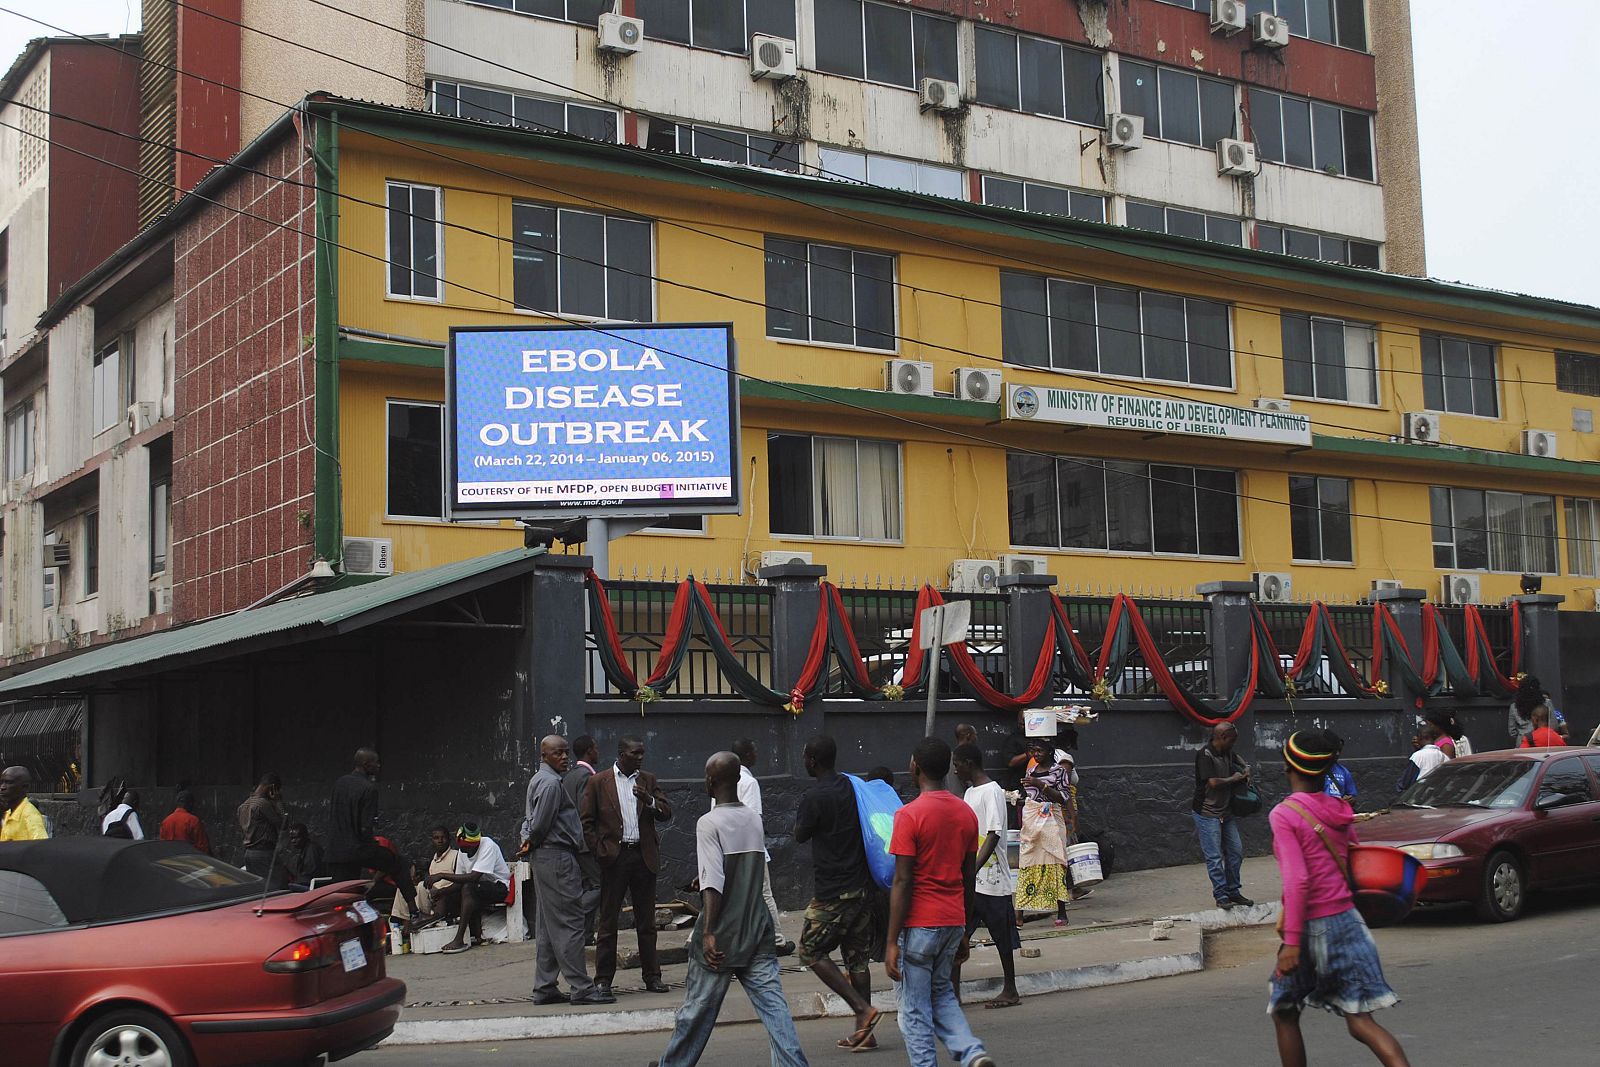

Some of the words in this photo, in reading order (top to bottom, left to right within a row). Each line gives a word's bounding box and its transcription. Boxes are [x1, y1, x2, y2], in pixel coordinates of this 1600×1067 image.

[522, 349, 666, 373] EBOLA
[505, 383, 683, 410] DISEASE
[1047, 390, 1098, 411] MINISTRY
[1101, 395, 1115, 413] OF
[1118, 397, 1162, 418] FINANCE
[1165, 402, 1185, 420] AND
[1188, 404, 1257, 427] DEVELOPMENT
[1260, 413, 1306, 431] PLANNING
[479, 419, 709, 447] OUTBREAK
[1107, 415, 1163, 430] REPUBLIC
[1166, 421, 1181, 431] OF
[1184, 423, 1227, 436] LIBERIA
[474, 455, 523, 468] (March
[526, 454, 547, 467] 22,
[550, 453, 584, 465] 2014
[598, 453, 649, 466] January
[651, 452, 673, 464] 06,
[675, 451, 715, 464] 2015)
[461, 487, 515, 496] COUTERSY
[517, 487, 531, 495] OF
[533, 486, 554, 494] THE
[556, 484, 598, 495] MFDP,
[600, 485, 629, 493] OPEN
[631, 483, 674, 492] BUDGET
[675, 482, 728, 491] INITIATIVE
[379, 545, 387, 569] Gibson
